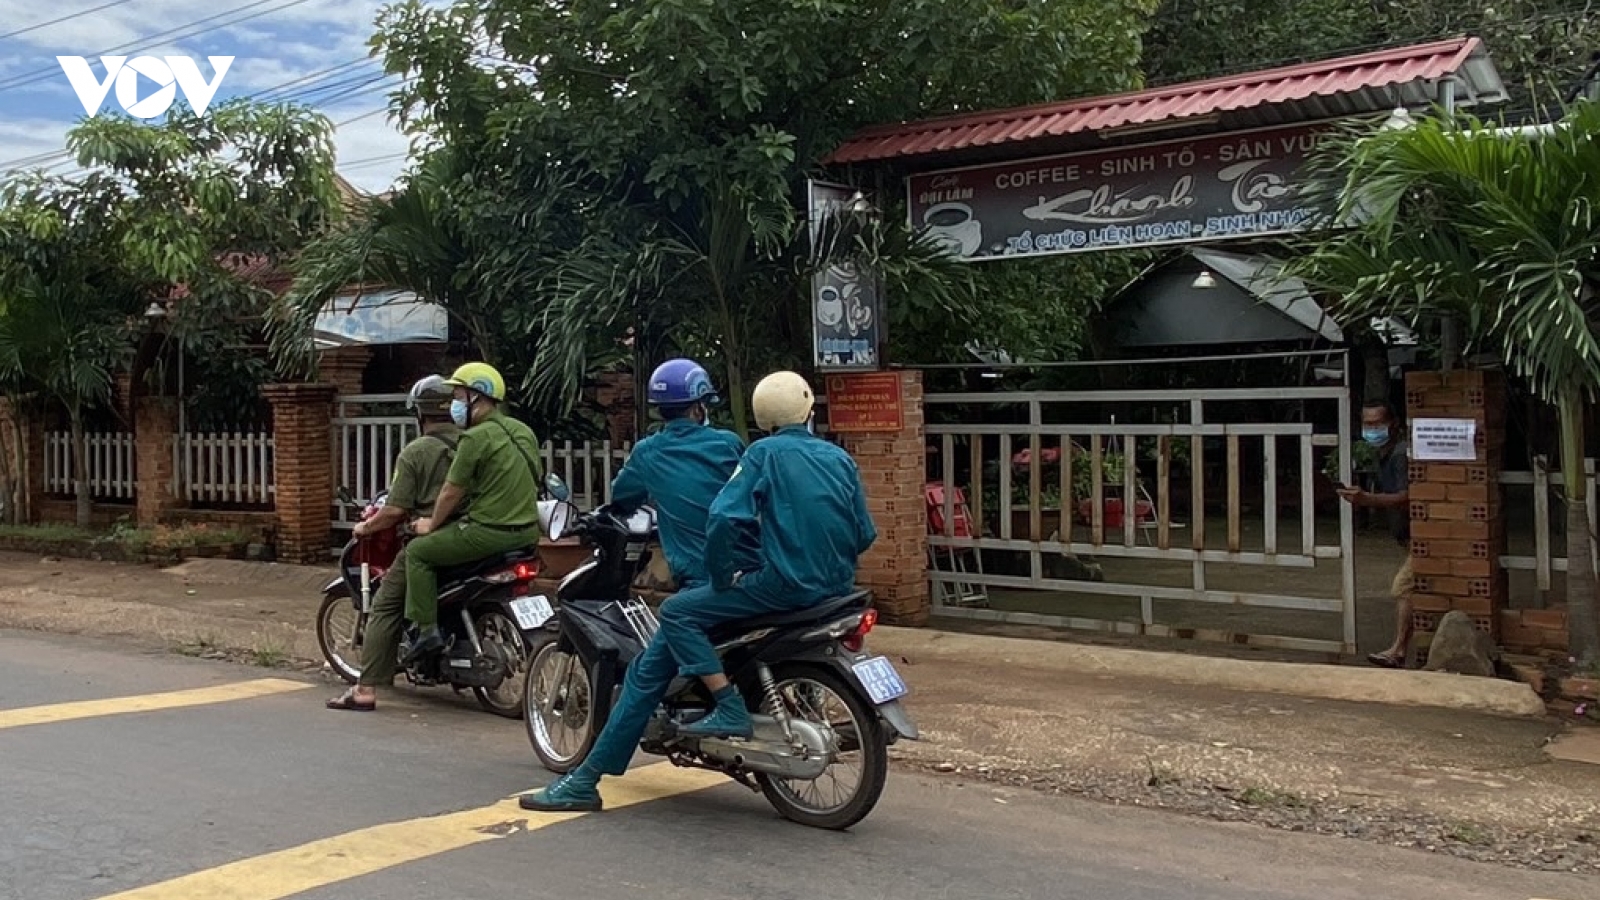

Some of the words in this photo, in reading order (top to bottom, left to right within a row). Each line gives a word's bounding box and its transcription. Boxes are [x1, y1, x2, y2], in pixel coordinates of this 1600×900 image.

[995, 164, 1081, 189] COFFEE
[1101, 156, 1155, 177] SINH
[1163, 142, 1196, 168] TỐ
[1219, 138, 1271, 161] SÂN
[1089, 224, 1133, 245] LIÊN
[1206, 212, 1257, 232] SINH
